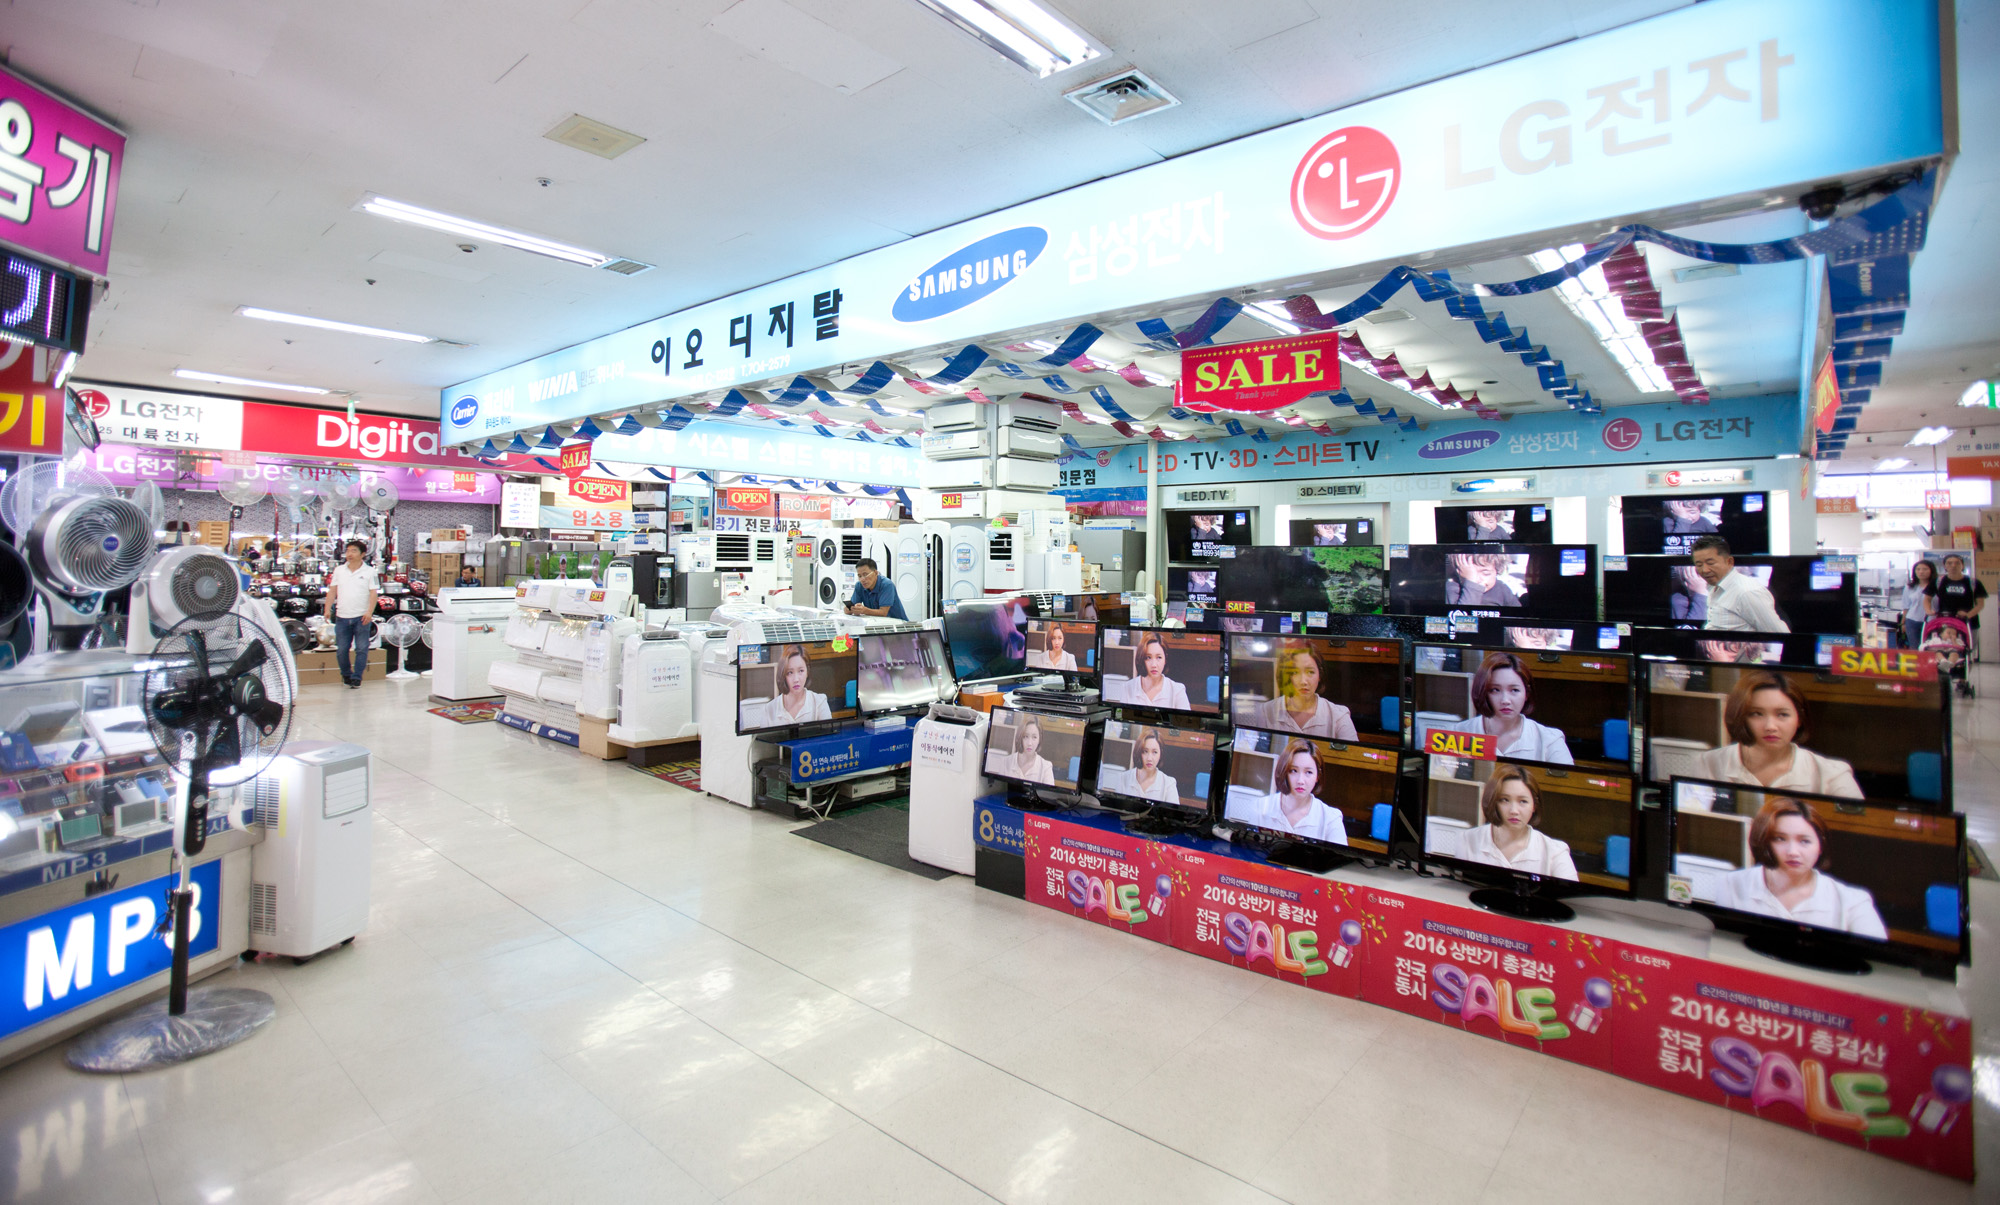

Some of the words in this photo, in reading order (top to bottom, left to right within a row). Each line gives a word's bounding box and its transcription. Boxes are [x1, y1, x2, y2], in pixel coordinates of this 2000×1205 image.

[1443, 38, 1795, 190] LG전자
[1063, 191, 1231, 286] 삼성전자
[908, 249, 1029, 302] SAMSUNG
[651, 328, 704, 377] 이오
[729, 288, 843, 360] 디지탈
[1196, 349, 1324, 393] SALE
[527, 370, 578, 403] WINIA
[120, 399, 204, 423] LG전자
[453, 404, 477, 421] Carrier
[123, 426, 200, 445] 대륙전자
[317, 414, 447, 459] Digita
[1655, 416, 1754, 443] LG전자
[1427, 437, 1490, 452] SAMSUNG
[1508, 431, 1580, 454] 삼성전자
[562, 449, 589, 469] SALE
[455, 473, 475, 483] SALE
[573, 481, 624, 498] OPEN
[731, 491, 768, 504] OPEN
[942, 495, 962, 506] SALE
[1184, 489, 1228, 502] LED.TV
[1300, 484, 1362, 497] 3D.스마트TV
[572, 510, 624, 528] 업소용
[796, 545, 811, 555] SALE
[590, 591, 605, 601] SALE
[1228, 602, 1250, 612] SALE
[1840, 650, 1918, 678] SALE
[1431, 732, 1485, 757] SALE
[42, 852, 108, 883] MP3
[1050, 846, 1075, 865] 2016
[1078, 853, 1106, 872] 상반기
[1108, 861, 1139, 881] 총결산
[1184, 854, 1205, 866] LG전자
[1046, 866, 1065, 882] 전국
[1046, 882, 1065, 899] 동시
[1067, 869, 1148, 924] SALE
[1203, 884, 1236, 906] 2016
[1238, 893, 1275, 916] 상반기
[1278, 902, 1318, 926] 총결산
[1378, 896, 1405, 909] LG전자
[1196, 908, 1220, 928] 전국
[1196, 926, 1220, 945] 동시
[1223, 911, 1328, 977] SALE
[1395, 956, 1427, 981] 전국
[1404, 931, 1447, 956] 2016
[1449, 942, 1498, 969] 상반기
[1501, 953, 1556, 983] 총결산
[1635, 954, 1671, 971] LG전자
[1395, 978, 1427, 1001] 동시
[1431, 963, 1570, 1041] SALE
[1658, 1026, 1703, 1056] 전국
[1671, 996, 1730, 1028] 2016
[1734, 1010, 1803, 1048] 상반기
[1809, 1028, 1886, 1068] 총결산
[1658, 1050, 1703, 1079] 동시
[1710, 1037, 1911, 1137] SALE
